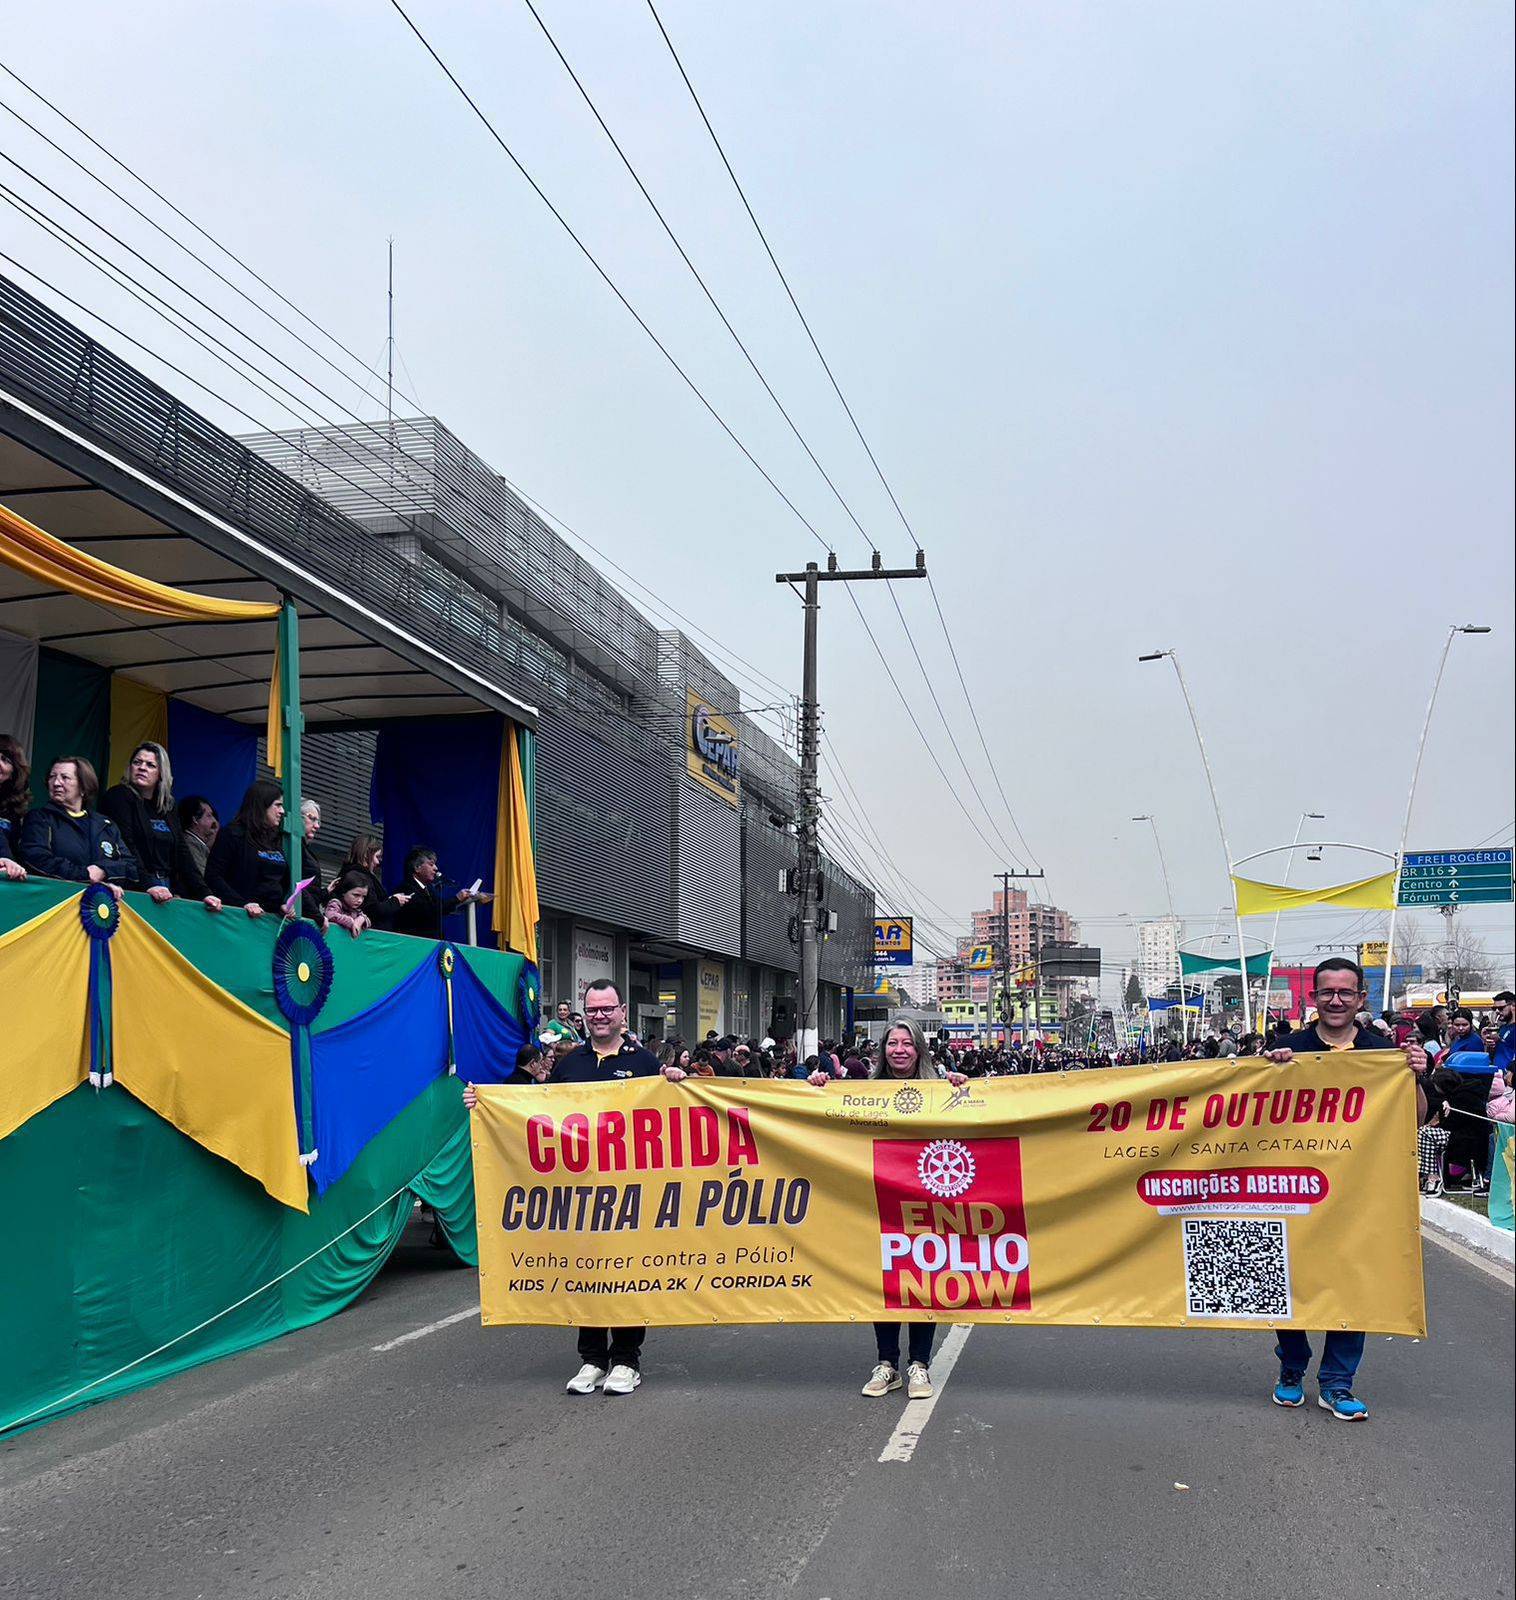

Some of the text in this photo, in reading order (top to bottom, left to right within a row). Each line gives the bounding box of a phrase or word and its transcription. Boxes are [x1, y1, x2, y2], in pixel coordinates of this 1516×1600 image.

[1418, 855, 1445, 864] FREI
[1449, 851, 1506, 863] ROGÉRIO
[1402, 866, 1444, 876] BR 116
[1402, 880, 1442, 889] Centro
[1402, 892, 1440, 902] Fórum
[842, 1094, 890, 1108] Rotary
[1087, 1086, 1367, 1133] 20 DE OUTUBRO
[825, 1108, 889, 1119] Club de Lages
[526, 1106, 760, 1175] CORRIDA
[1103, 1146, 1160, 1159] LAGES
[1190, 1141, 1249, 1155] SANTA
[1256, 1138, 1352, 1152] CATARINA
[1144, 1173, 1321, 1200] INSCRIÇÕES ABERTAS
[501, 1167, 812, 1232] CONTRA A PÓLIO
[901, 1201, 1005, 1235] END
[511, 1246, 795, 1270] Venha correr contra a Pólio!
[880, 1233, 1029, 1272] POLIO
[508, 1274, 813, 1294] KIDS / CAMINHADA 2K / CORRIDA 5K
[899, 1268, 1018, 1308] NOW
